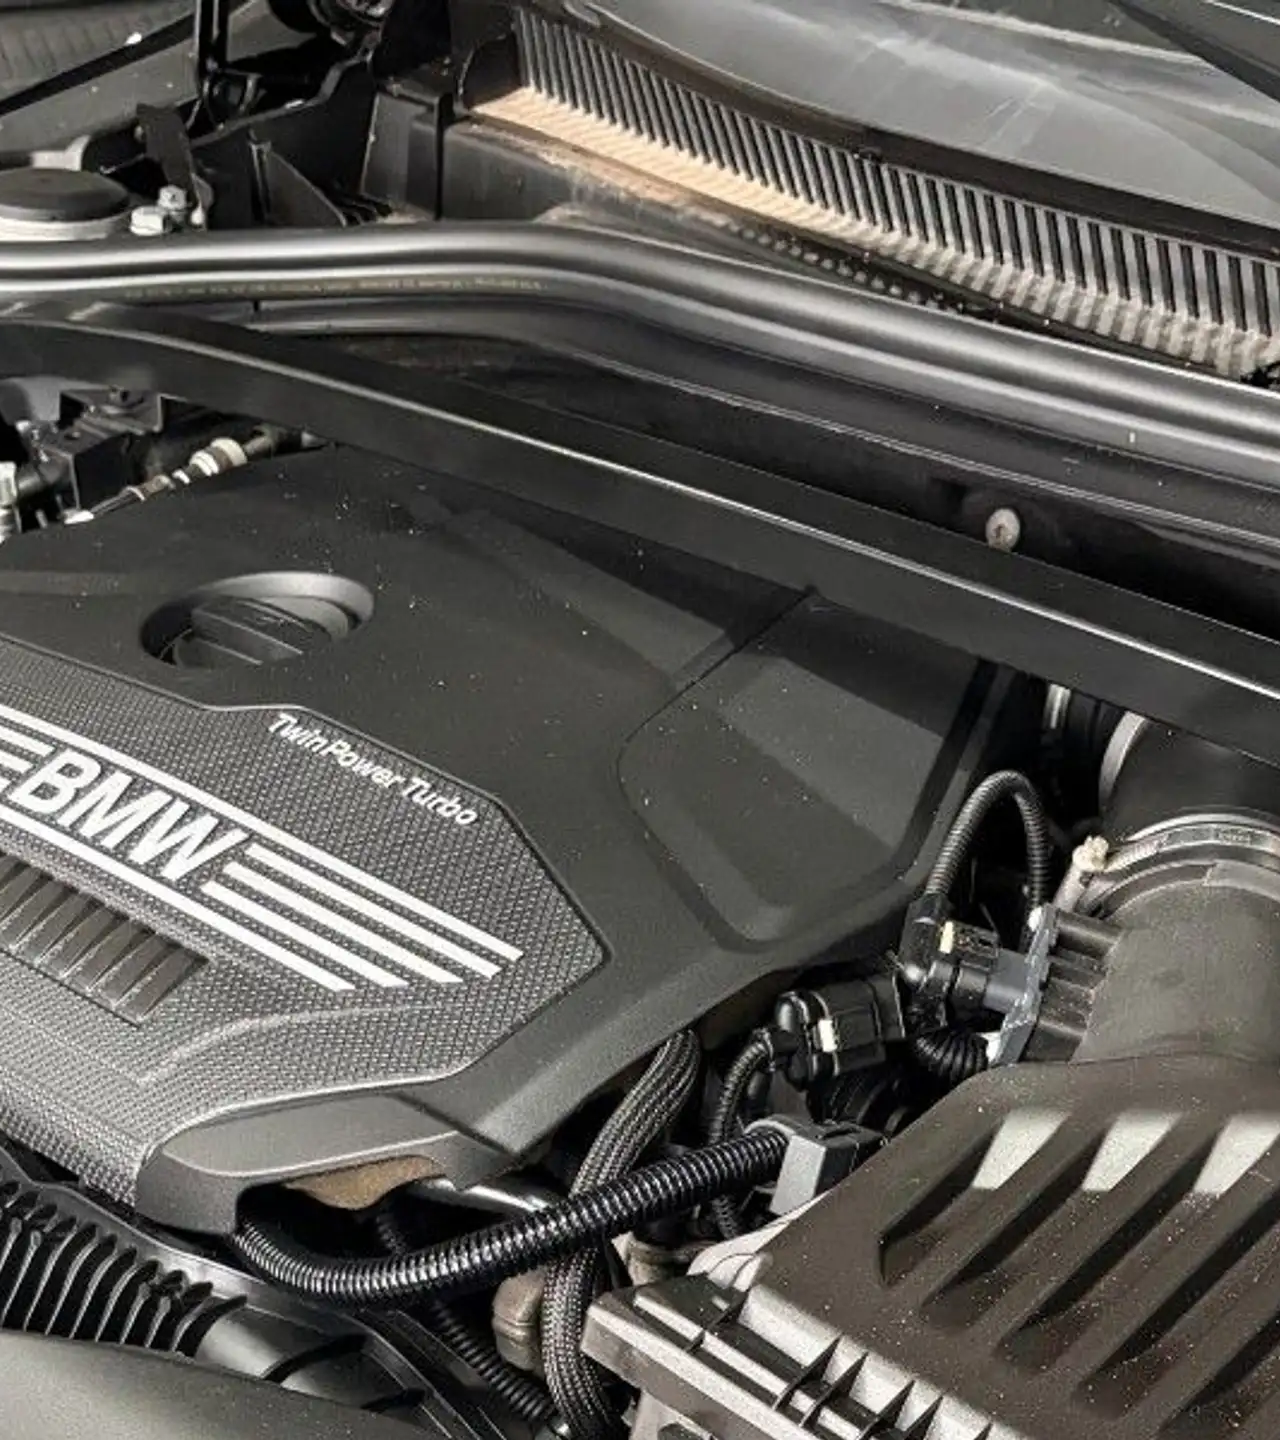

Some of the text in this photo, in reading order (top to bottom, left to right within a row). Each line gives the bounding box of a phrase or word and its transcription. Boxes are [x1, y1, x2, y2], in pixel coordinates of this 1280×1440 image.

[6, 749, 248, 880] BMW
[268, 712, 478, 826] TwinPower Turbo
